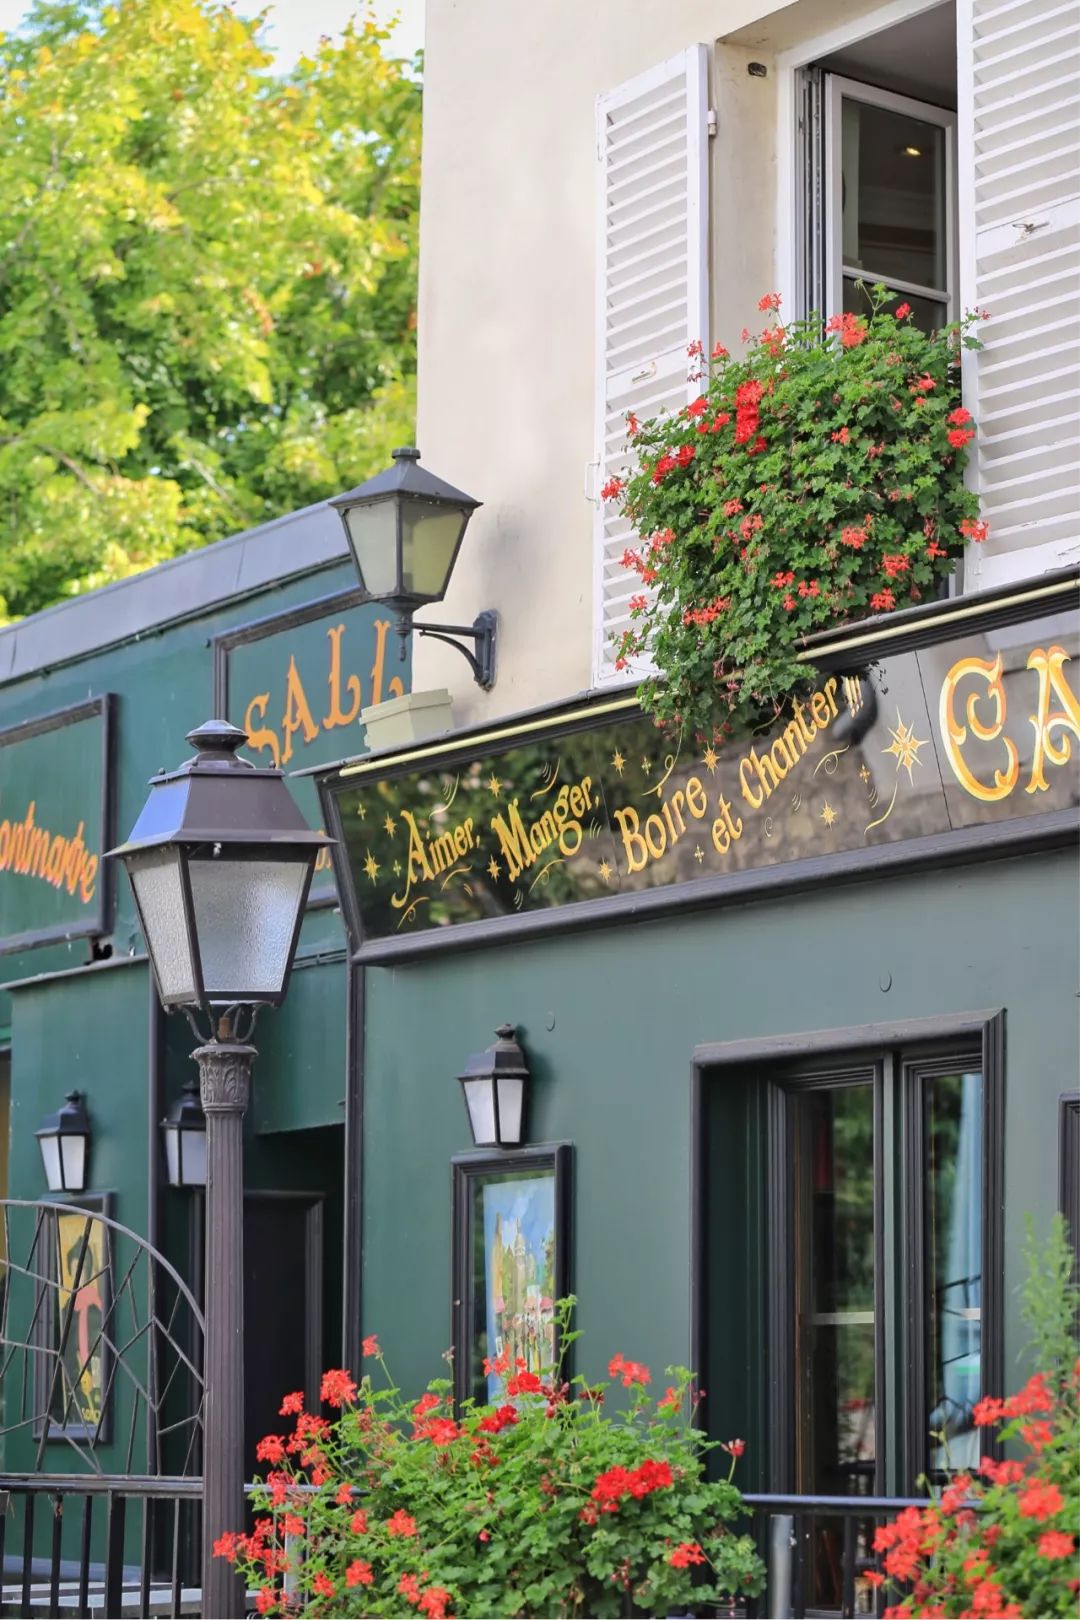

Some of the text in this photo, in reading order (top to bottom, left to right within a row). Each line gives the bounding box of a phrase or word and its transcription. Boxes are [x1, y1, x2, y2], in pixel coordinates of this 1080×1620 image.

[939, 645, 1080, 801] CA
[391, 810, 481, 908] Aimer,
[491, 776, 599, 883] Manger,
[614, 776, 708, 874] Boire
[712, 792, 743, 854] et
